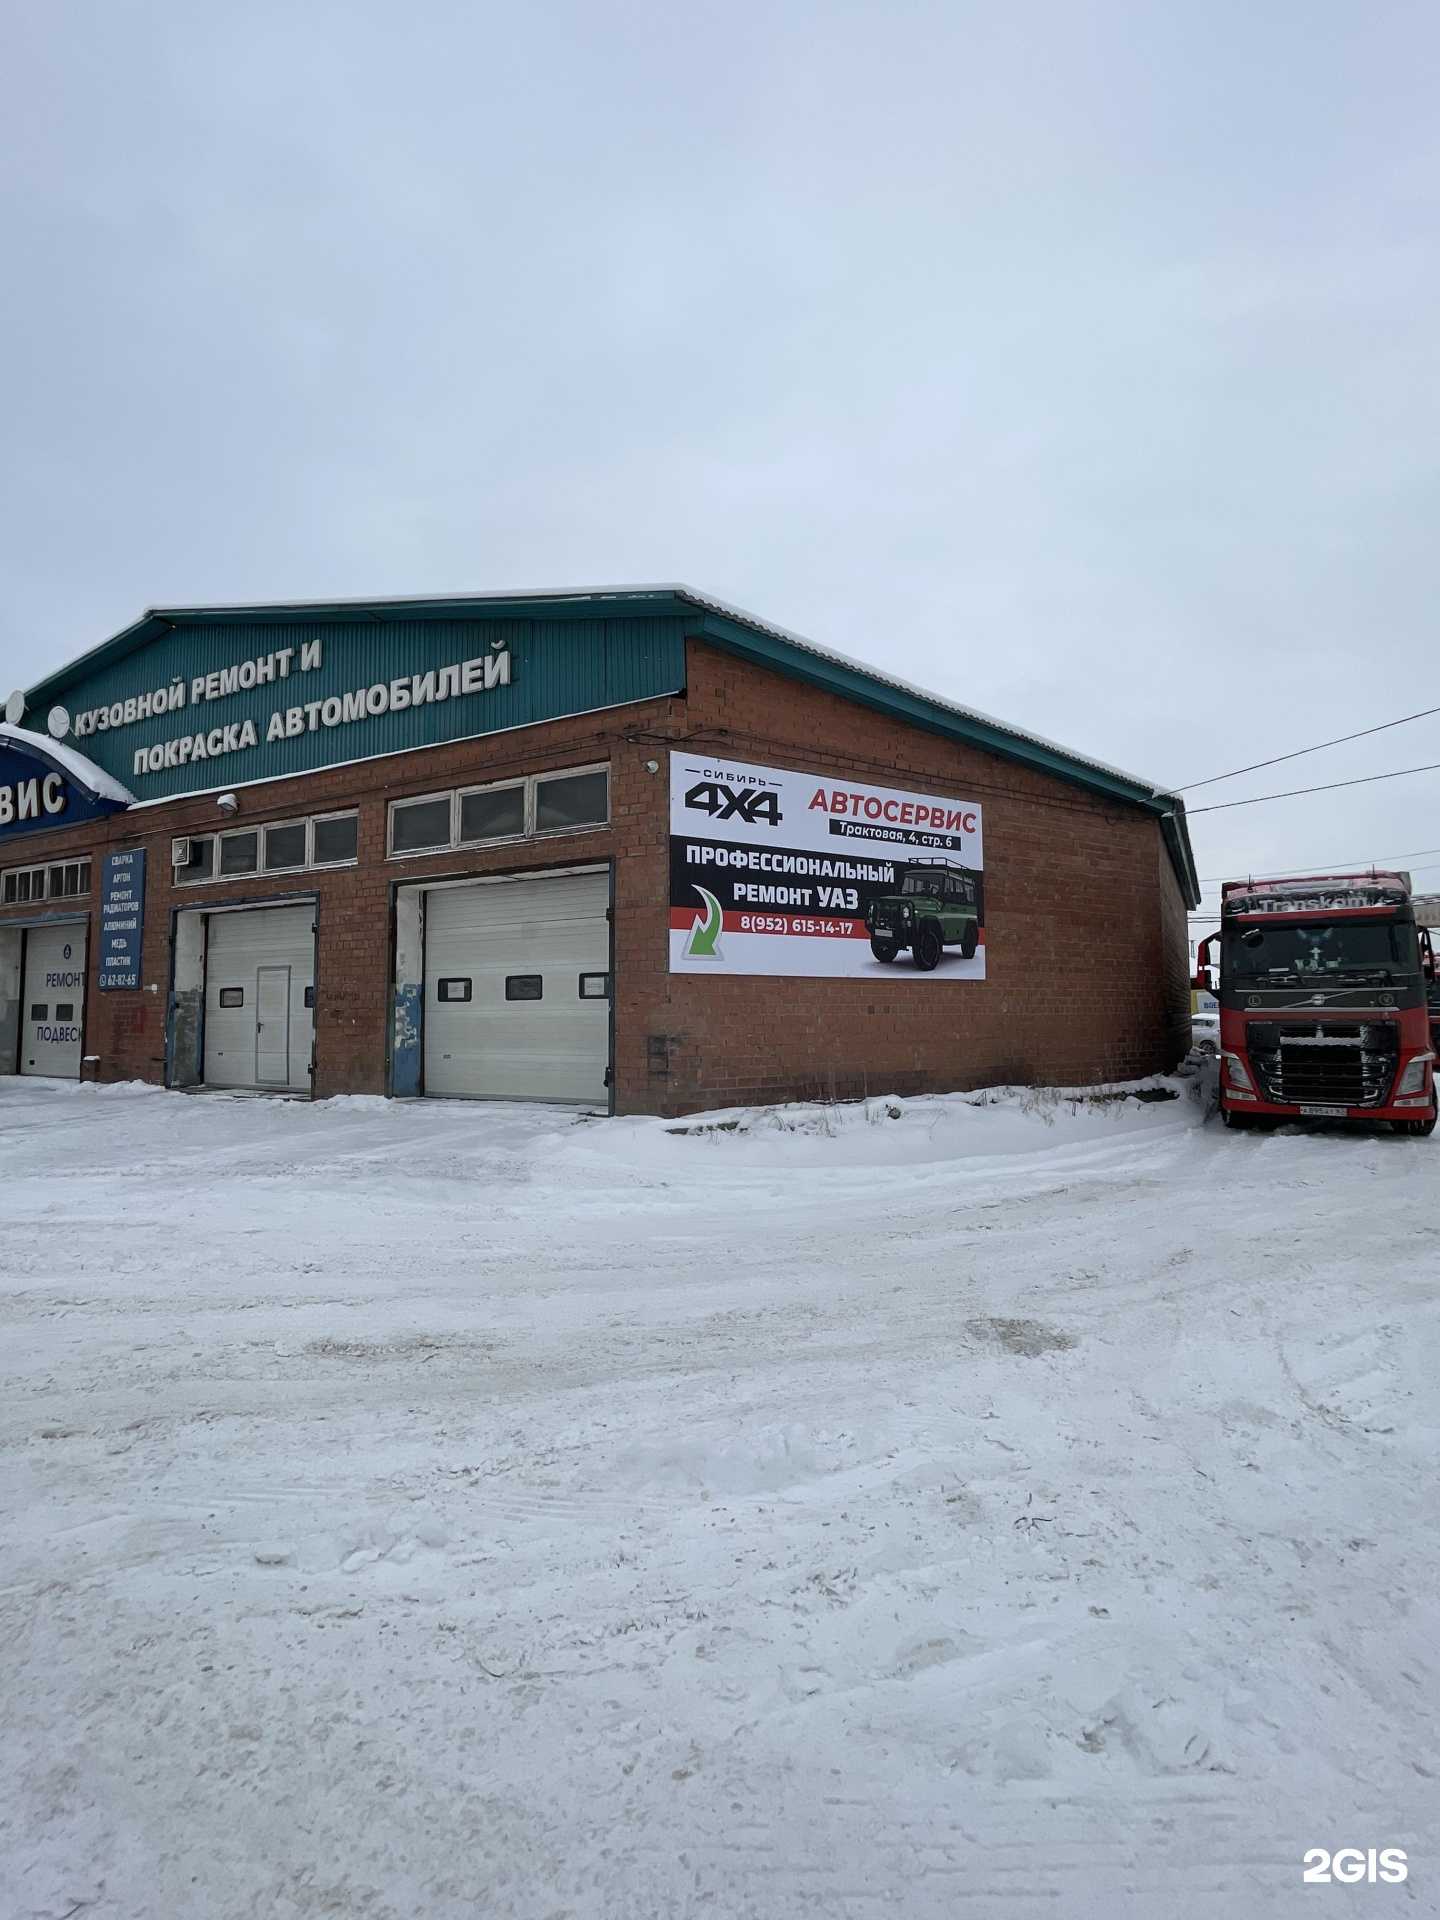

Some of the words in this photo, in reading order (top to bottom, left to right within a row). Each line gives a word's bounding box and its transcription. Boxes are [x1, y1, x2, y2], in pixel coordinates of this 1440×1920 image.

[74, 676, 187, 737] КУЗОВНОЙ
[191, 648, 294, 704] РЕМОНТ
[301, 639, 322, 671] И
[133, 720, 258, 775] ПОКРАСКА
[266, 640, 512, 741] АВТОМОБИЛЕЙ
[703, 769, 766, 786] СИБИРЬ
[808, 788, 978, 834] АВТОСЕРВИС
[839, 821, 906, 843] Трактовая,
[908, 831, 919, 845] 4,
[921, 835, 943, 848] стр.
[945, 836, 953, 848] 6
[111, 854, 133, 865] СВАРКА
[686, 845, 895, 884] ПРОФЕССИОНАЛЬНЫЙ
[112, 872, 131, 883] АРГОН
[110, 890, 133, 901] РЕМОНТ
[733, 882, 812, 906] РЕМОНТ
[816, 885, 859, 910] УАЗ
[103, 902, 139, 913] РАДИАТОРОВ
[104, 917, 137, 931] АЛЮМИНИЙ
[741, 916, 788, 933] 8(952)
[792, 919, 853, 935] 615-14-17
